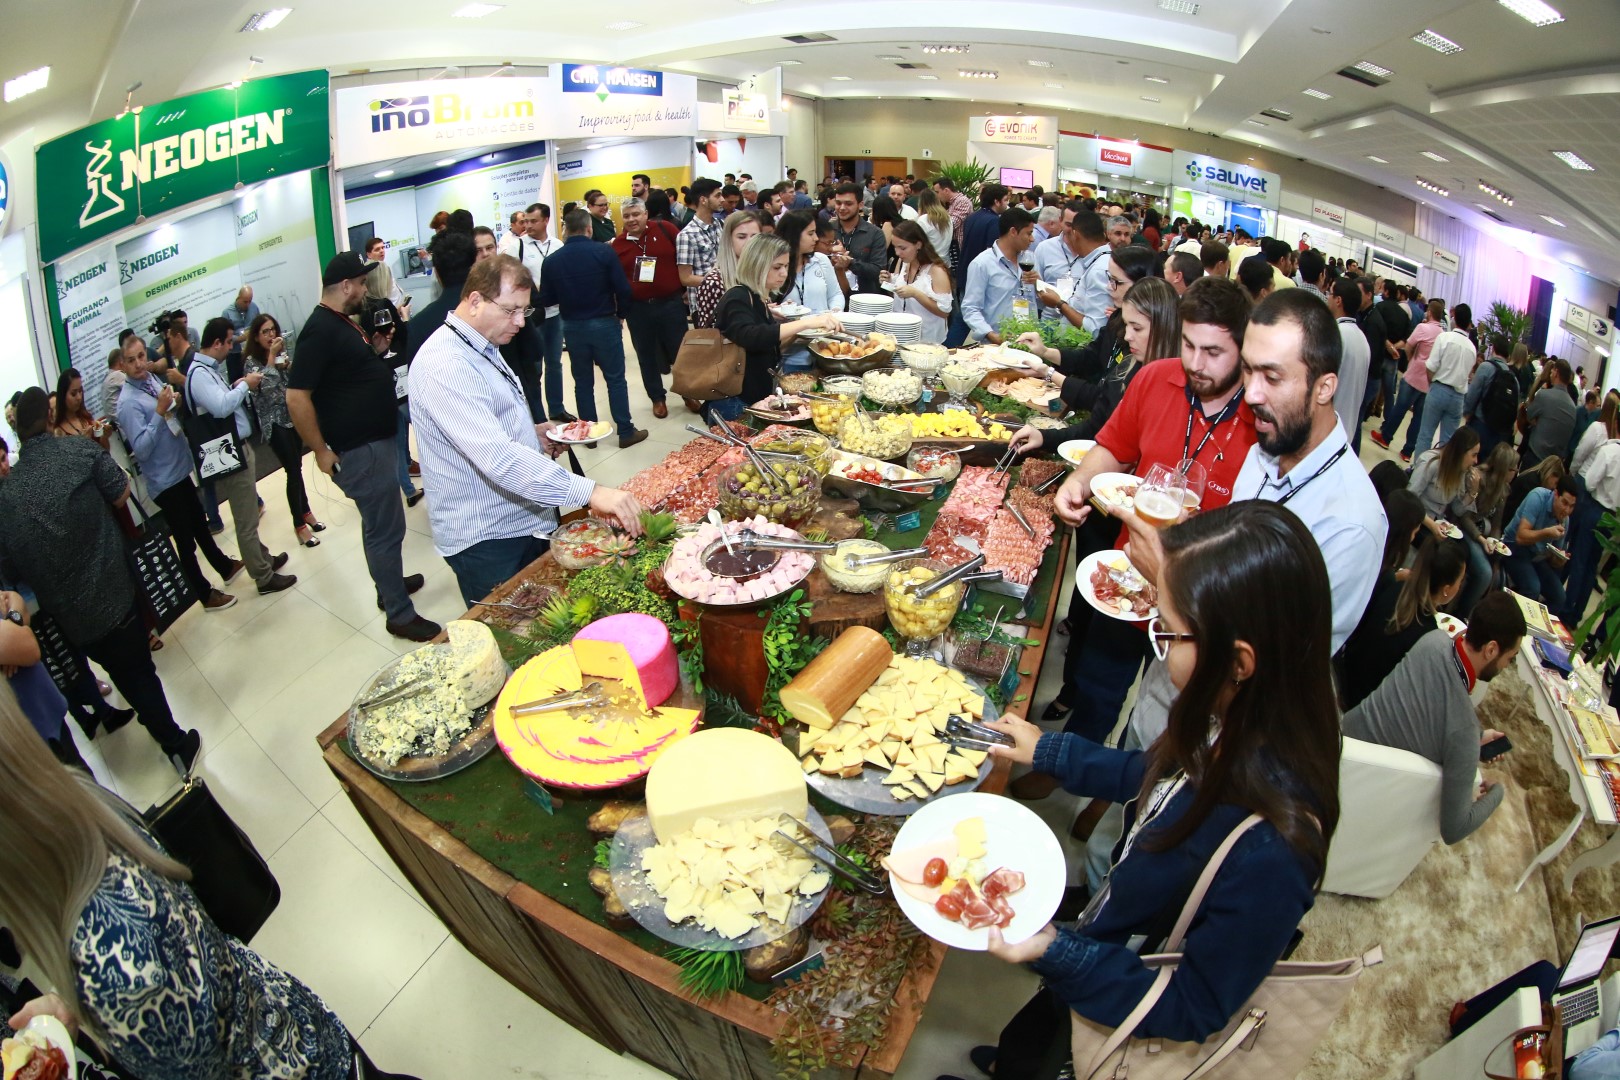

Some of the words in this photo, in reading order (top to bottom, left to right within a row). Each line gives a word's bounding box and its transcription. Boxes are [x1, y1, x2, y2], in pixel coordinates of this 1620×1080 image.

[606, 68, 657, 88] HANSEN
[579, 113, 631, 133] Improving
[631, 108, 652, 130] food
[654, 110, 663, 121] &
[665, 106, 691, 120] health
[1000, 122, 1038, 134] EVONIK
[120, 108, 285, 190] NEOGEN
[508, 169, 530, 178] completas
[1205, 166, 1267, 193] sauvet
[130, 243, 180, 275] NEOGEN
[64, 261, 107, 292] NEOGEN
[145, 266, 208, 298] DESINFETANTES
[72, 310, 102, 330] ANIMAL
